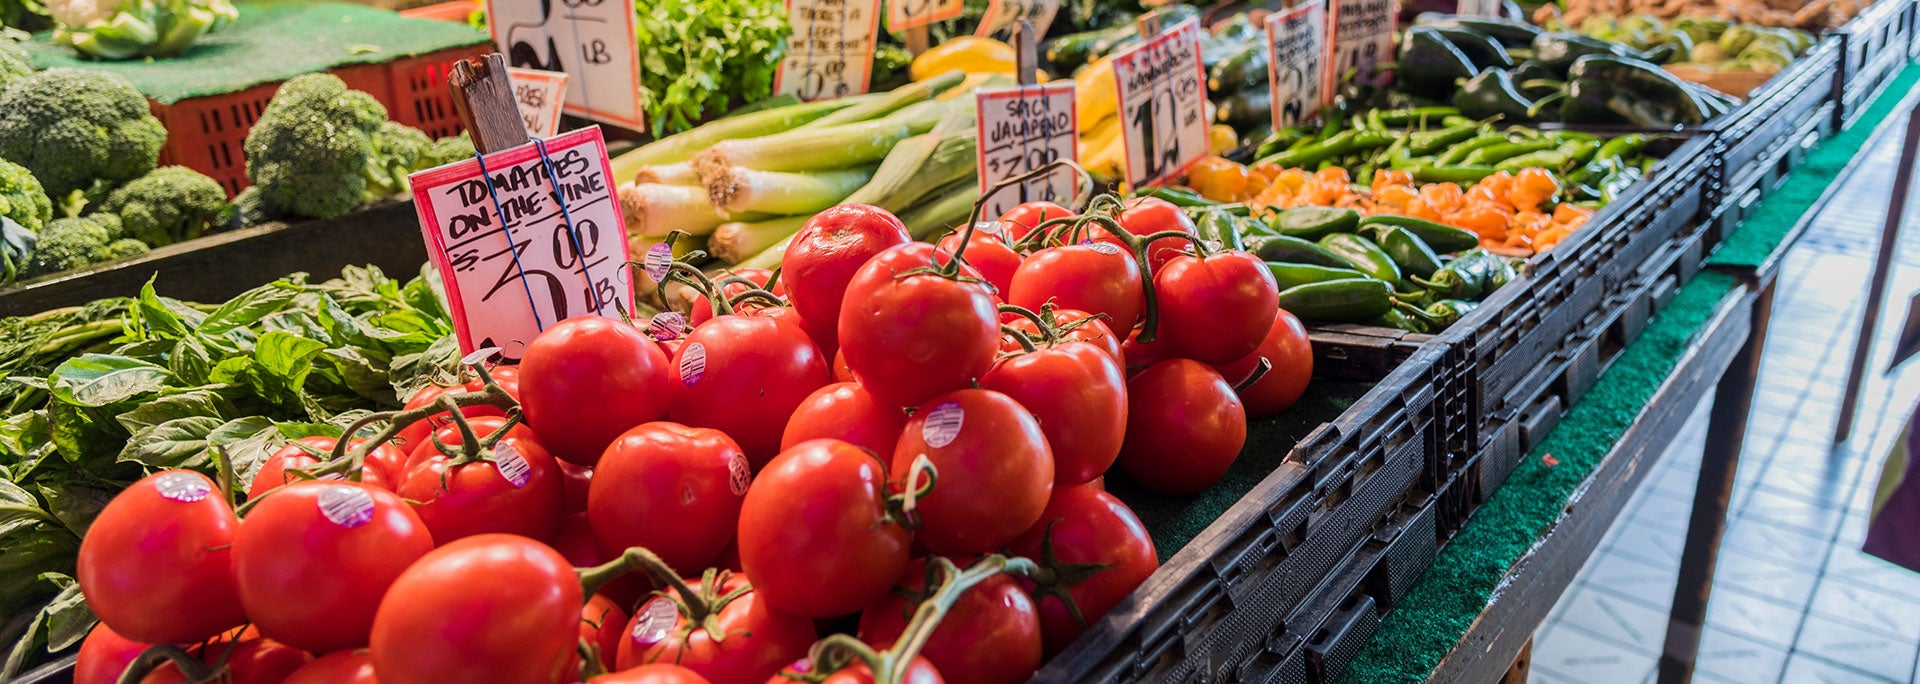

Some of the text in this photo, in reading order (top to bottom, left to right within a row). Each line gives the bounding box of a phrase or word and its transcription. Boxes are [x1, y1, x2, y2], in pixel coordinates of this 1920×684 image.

[581, 37, 613, 66] LB
[446, 150, 590, 207] TOMATOES
[584, 277, 617, 313] LB
